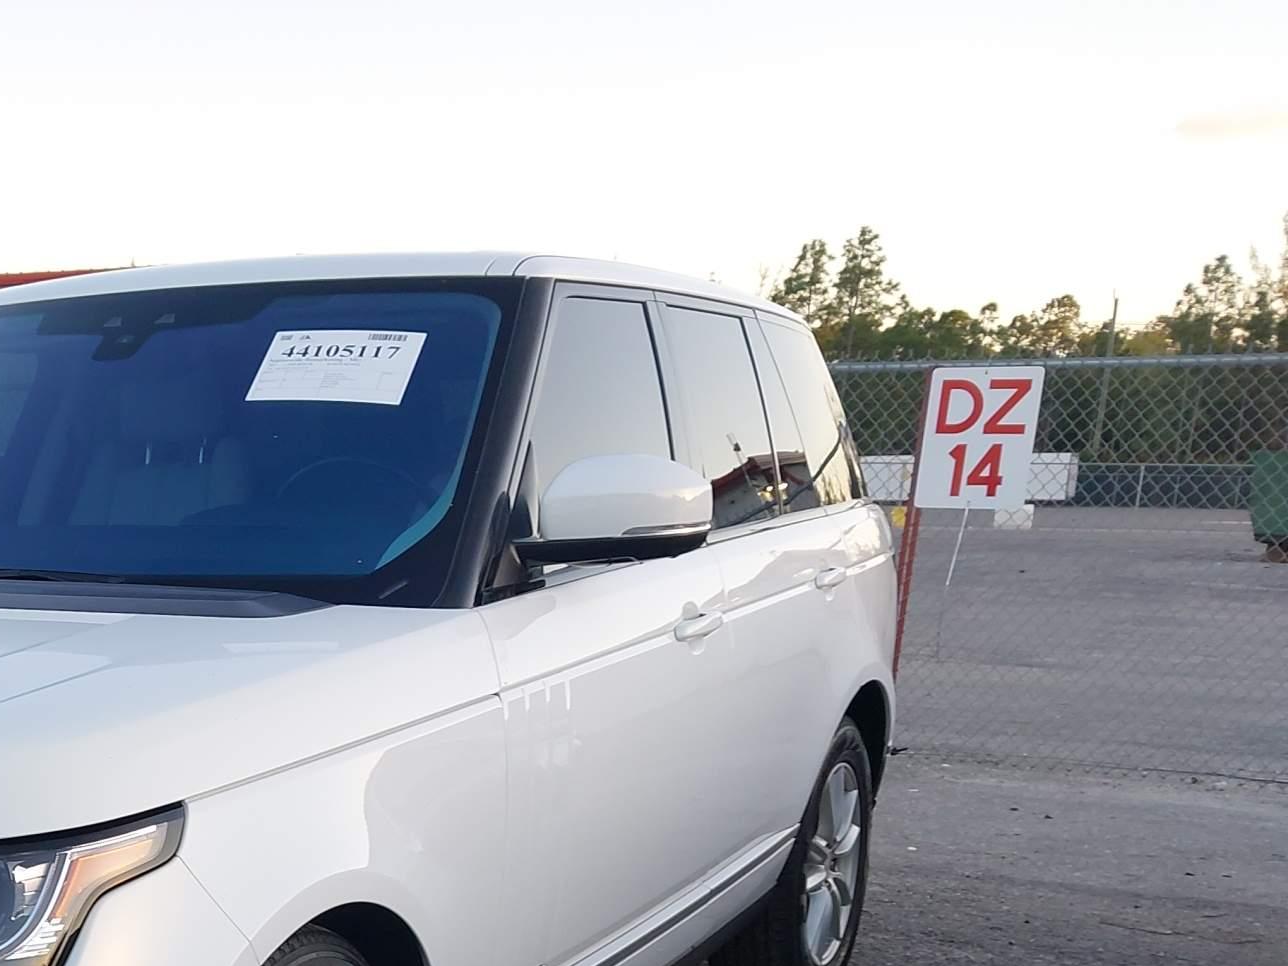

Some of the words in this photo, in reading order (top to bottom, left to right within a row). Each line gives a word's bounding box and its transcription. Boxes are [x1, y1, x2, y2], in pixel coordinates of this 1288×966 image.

[281, 344, 402, 360] 44105117
[935, 378, 1033, 435] DZ
[948, 443, 1003, 497] 14
